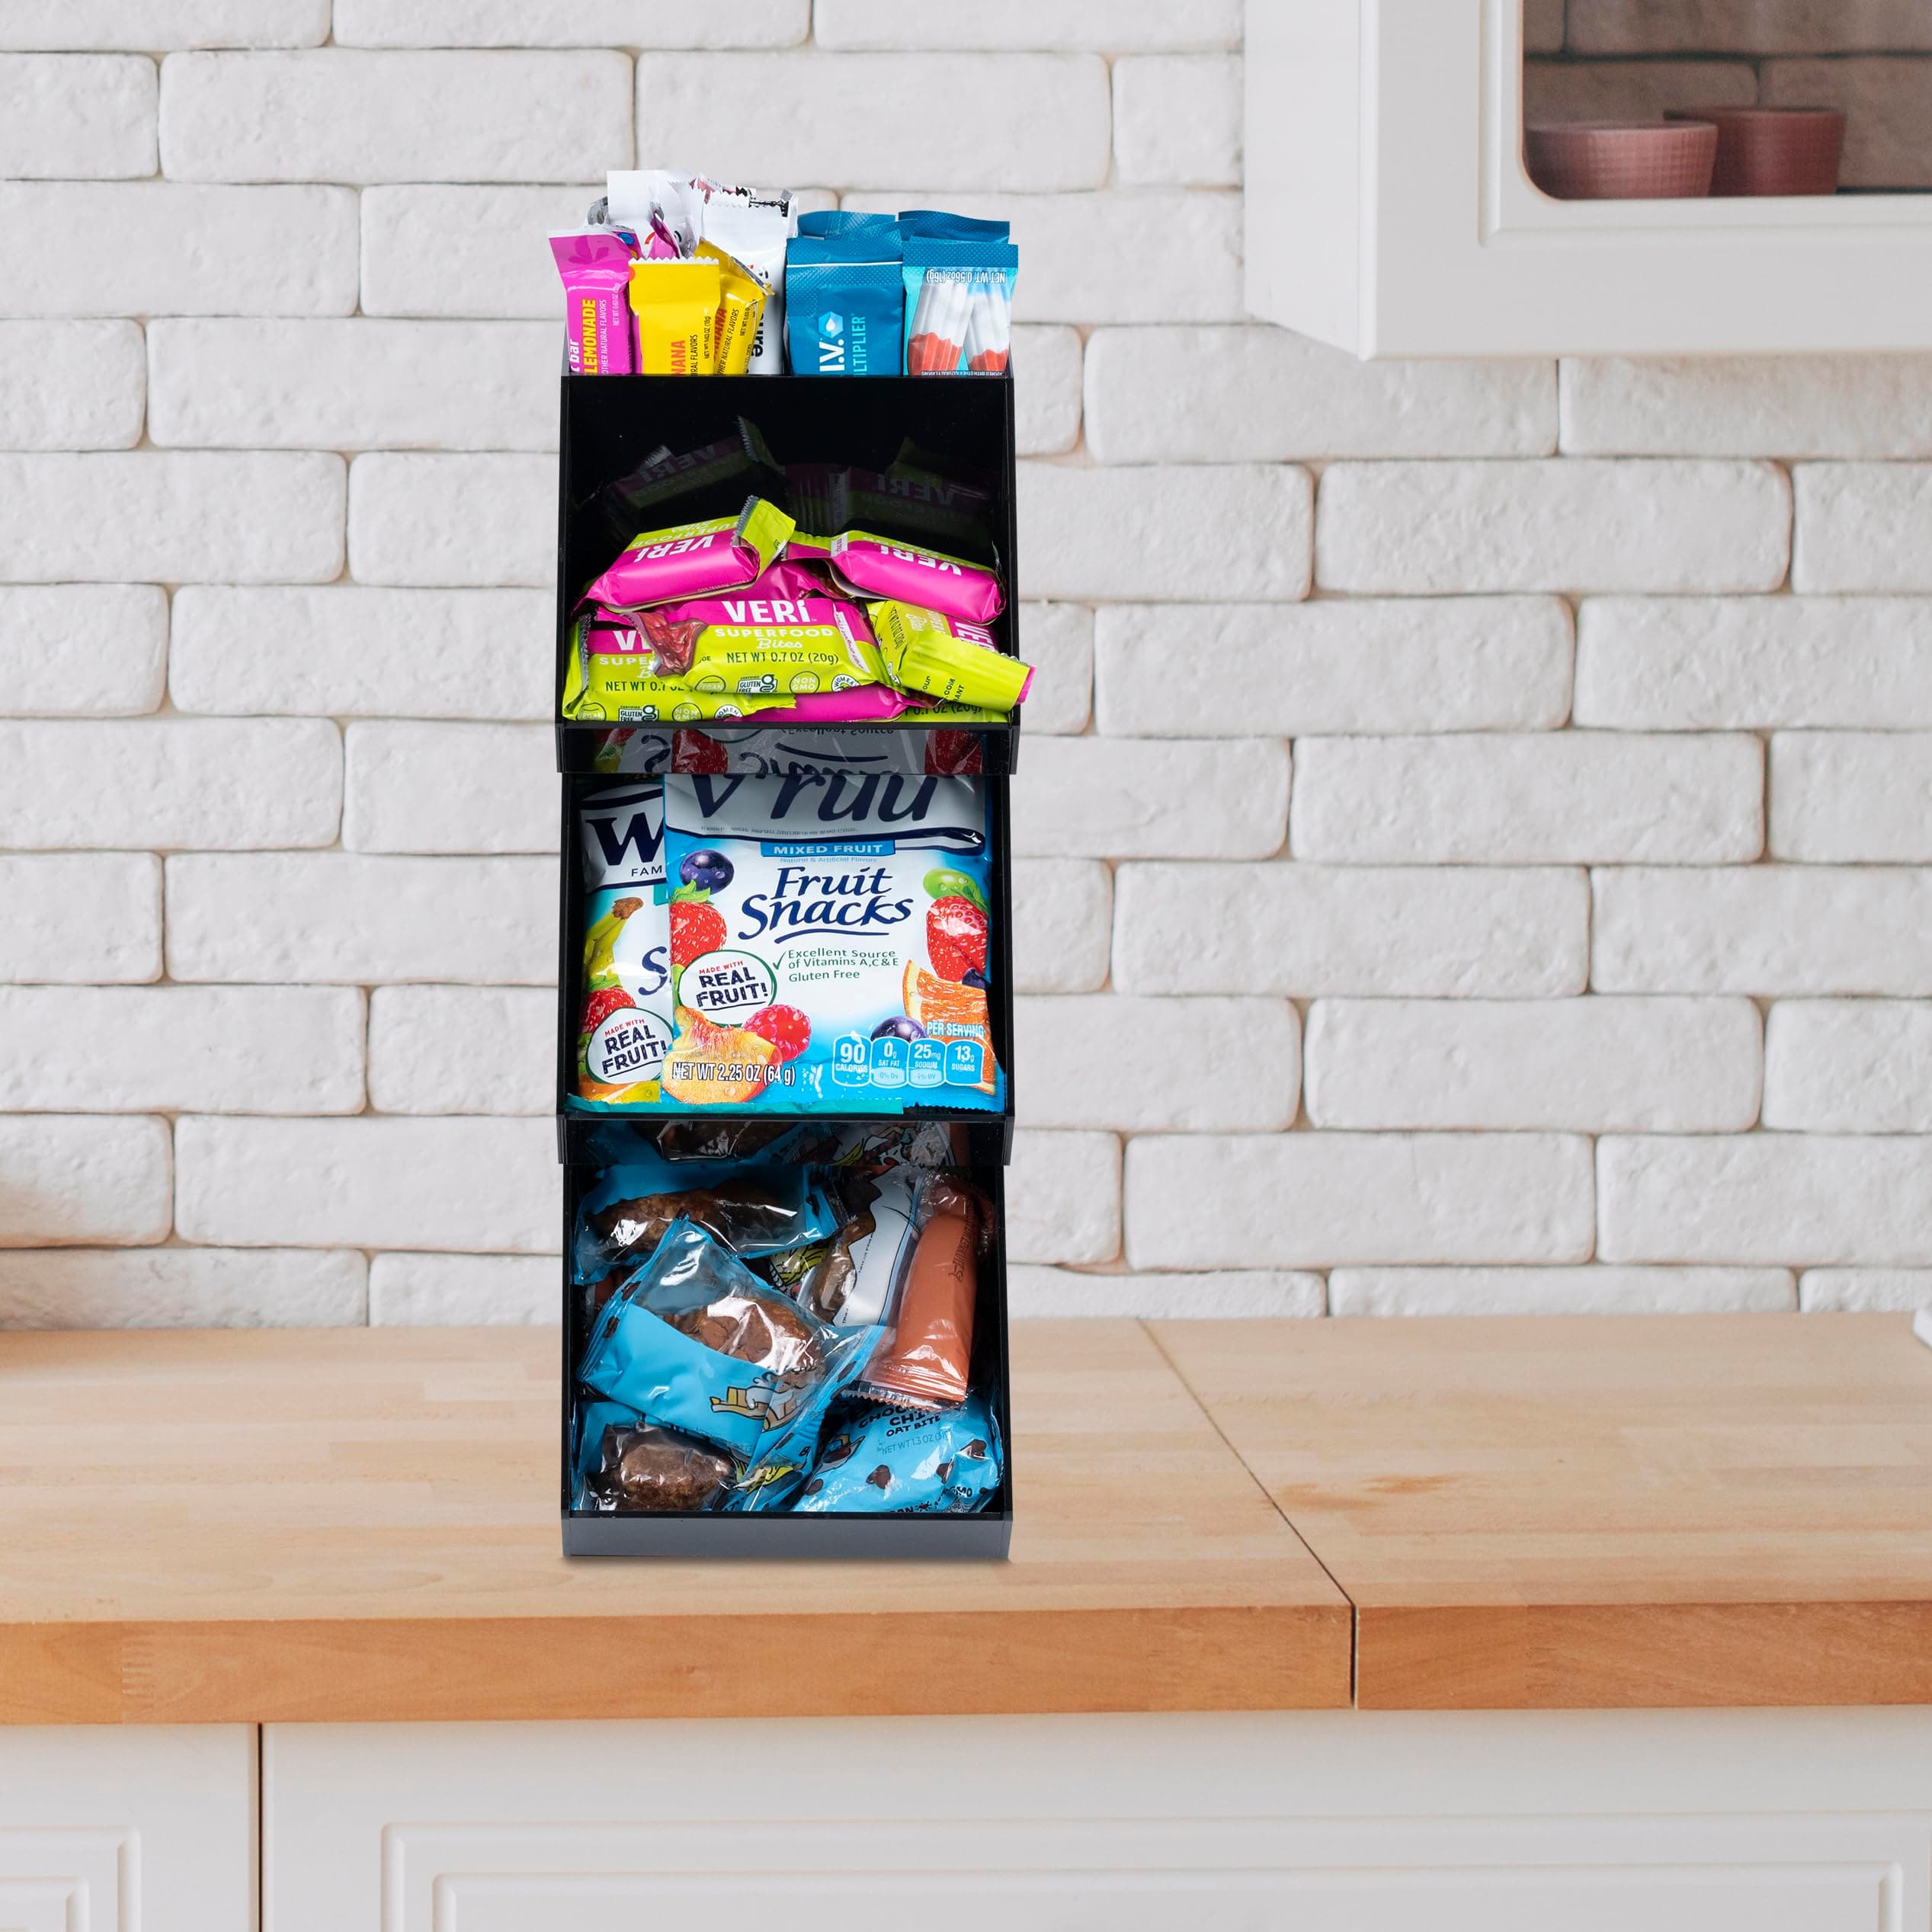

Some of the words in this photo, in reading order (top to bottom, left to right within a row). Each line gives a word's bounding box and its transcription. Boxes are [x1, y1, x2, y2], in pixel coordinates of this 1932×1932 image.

[926, 268, 946, 284] (16g)
[947, 272, 972, 284] 0.56oz
[990, 272, 1005, 284] NET
[598, 300, 607, 326] FLAVORS
[582, 298, 598, 373] LEMONADE
[600, 327, 608, 354] NATURAL
[720, 335, 732, 360] NATURAL
[726, 308, 739, 335] FLAVORS
[569, 339, 580, 364] bar
[690, 334, 698, 360] FLAVORS
[819, 339, 845, 372] I.V.
[715, 628, 834, 638] SUPERFOOD
[756, 638, 803, 649] Bites
[726, 652, 747, 664] NET
[751, 652, 767, 663] WT
[771, 652, 787, 662] 0.7
[790, 652, 804, 662] OZ
[809, 652, 839, 665] (20g)
[606, 681, 625, 691] NET
[630, 681, 647, 691] WT
[922, 676, 931, 690] our
[774, 844, 828, 854] MIXED
[834, 844, 883, 854] FRUIT
[631, 865, 662, 876] FAM
[771, 866, 893, 900] Fruit
[738, 895, 914, 942] Snacks
[788, 947, 847, 960] Excellent
[852, 949, 896, 959] Source
[638, 947, 671, 995] S
[699, 966, 722, 975] MADE
[723, 960, 744, 971] WITH
[788, 959, 800, 969] of
[803, 957, 856, 967] Vitamins
[698, 966, 756, 989] REAL
[788, 970, 831, 983] Gluten
[834, 969, 860, 979] Free
[696, 982, 769, 1008] FRUIT!
[604, 1024, 624, 1037] MADE
[625, 1018, 646, 1028] WITH
[926, 1021, 946, 1036] PER
[947, 1023, 985, 1039] SERVING
[604, 1025, 656, 1056] REAL
[601, 1040, 667, 1075] FRUIT!
[840, 1043, 866, 1064] 90
[671, 1061, 695, 1081] NET
[697, 1062, 716, 1081] WT
[717, 1063, 742, 1082] 2.25
[745, 1063, 761, 1082] OZ
[762, 1064, 782, 1086] (64
[783, 1065, 796, 1086] g)
[915, 1060, 938, 1069] SODIUM
[951, 1063, 976, 1072] SUGARS
[886, 1424, 912, 1437] OAT
[881, 1444, 896, 1456] NET
[898, 1439, 910, 1449] WT
[923, 1434, 934, 1443] OZ
